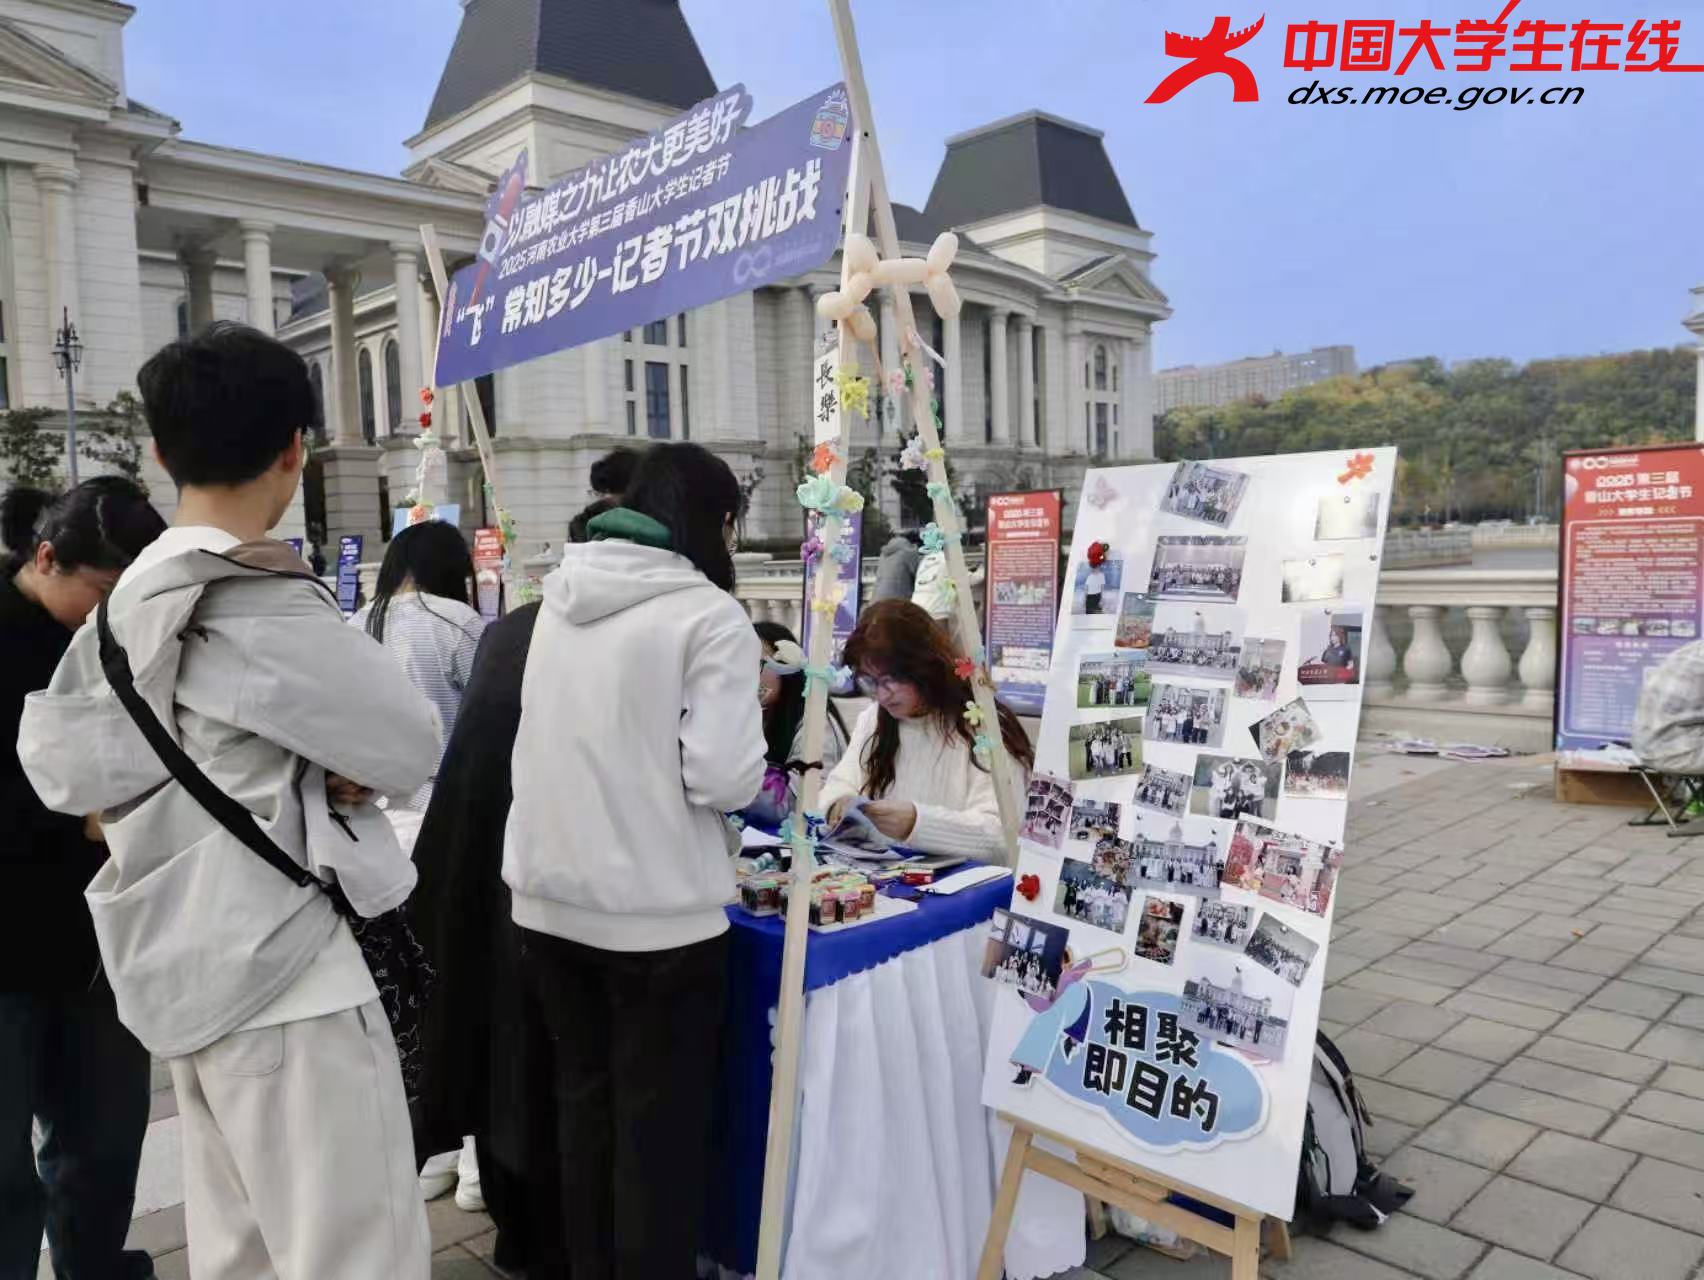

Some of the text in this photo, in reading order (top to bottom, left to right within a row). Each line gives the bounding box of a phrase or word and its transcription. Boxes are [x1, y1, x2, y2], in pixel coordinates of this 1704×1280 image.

[499, 92, 743, 257] 以融媒之力让农大更美好
[1103, 998, 1201, 1069] 相聚
[1082, 1041, 1220, 1132] 即目的
